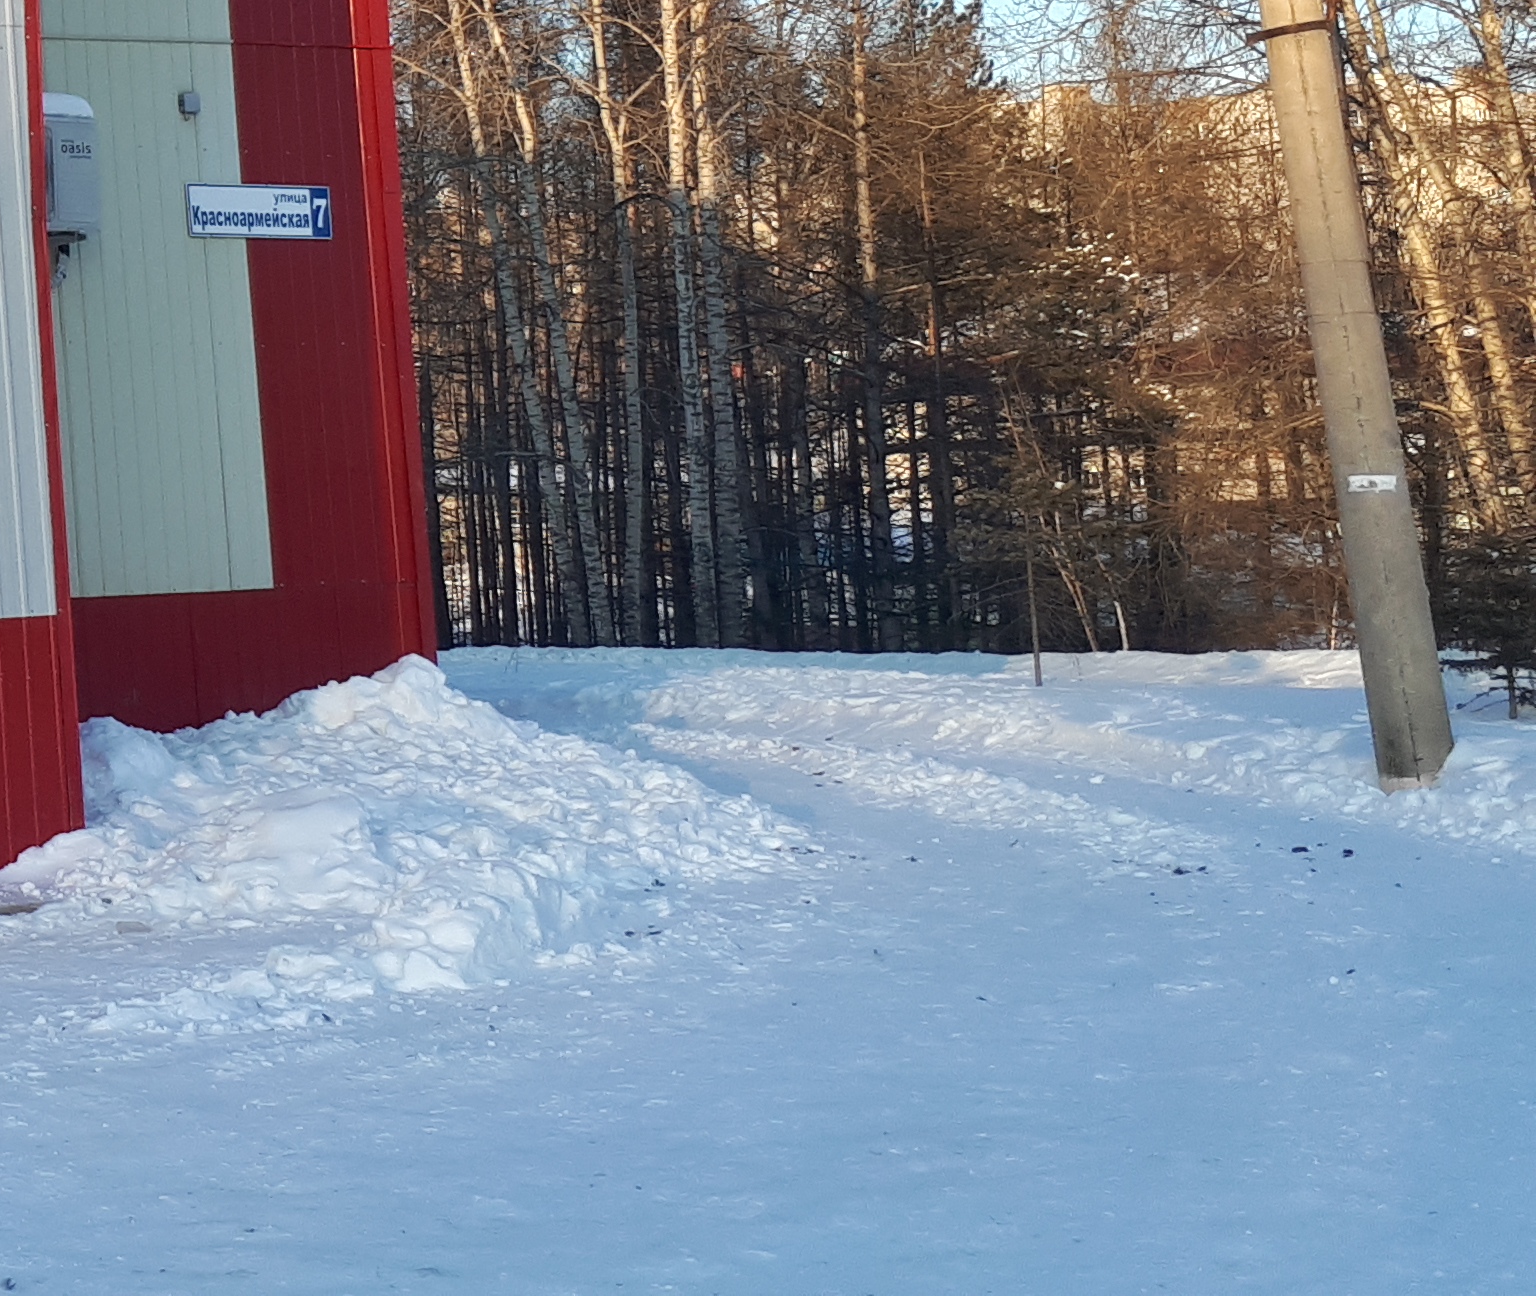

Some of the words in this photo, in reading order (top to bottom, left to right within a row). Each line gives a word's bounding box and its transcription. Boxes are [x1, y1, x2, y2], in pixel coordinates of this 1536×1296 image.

[61, 142, 91, 154] oasis
[273, 193, 307, 205] улица
[192, 205, 310, 232] Красноармейская
[313, 198, 327, 228] 7
